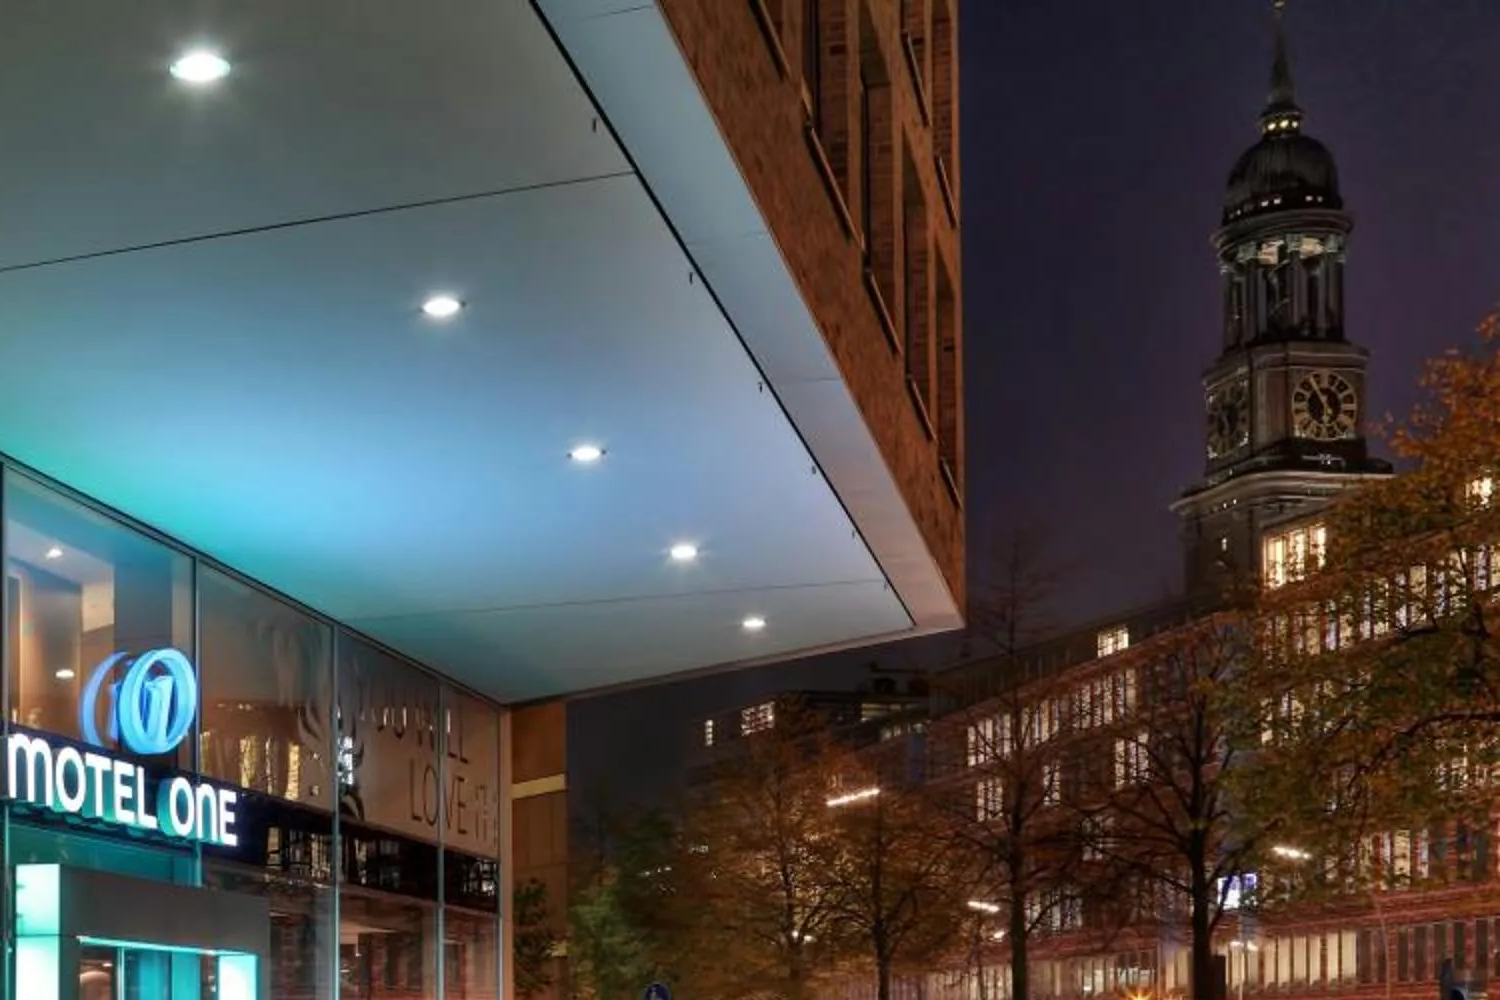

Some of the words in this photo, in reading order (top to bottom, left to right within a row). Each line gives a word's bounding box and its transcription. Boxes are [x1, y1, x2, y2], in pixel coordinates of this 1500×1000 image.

[7, 732, 158, 830] MOTEL
[164, 776, 238, 847] ONE
[410, 758, 468, 835] LOVE
